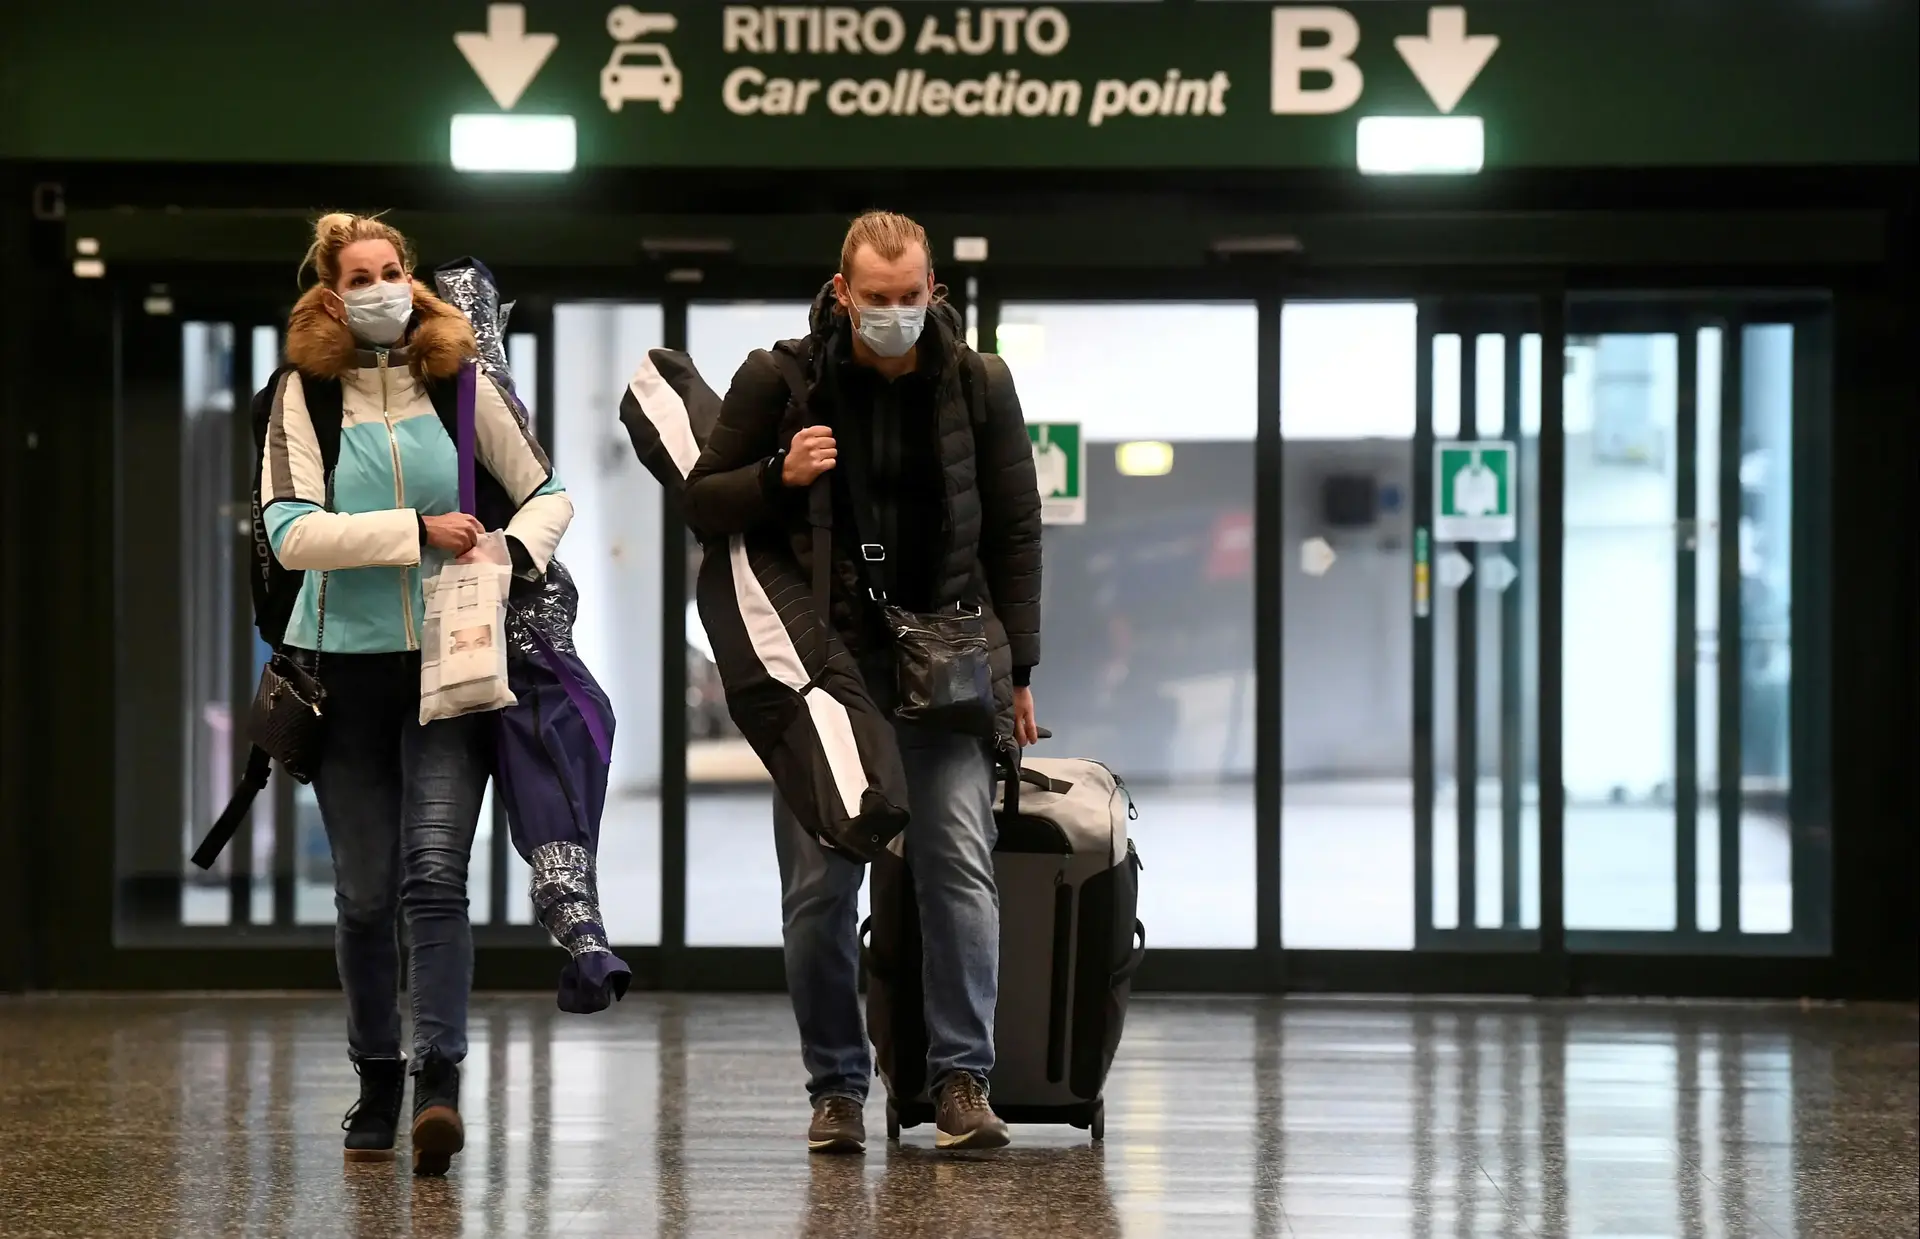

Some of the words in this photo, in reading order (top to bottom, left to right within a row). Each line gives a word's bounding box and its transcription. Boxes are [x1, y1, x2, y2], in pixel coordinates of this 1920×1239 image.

[723, 7, 905, 54] RITIRO
[915, 7, 1070, 55] AUTO
[1271, 7, 1364, 114] B
[722, 67, 820, 115] Car
[827, 69, 1081, 117] collection
[1088, 69, 1230, 126] point
